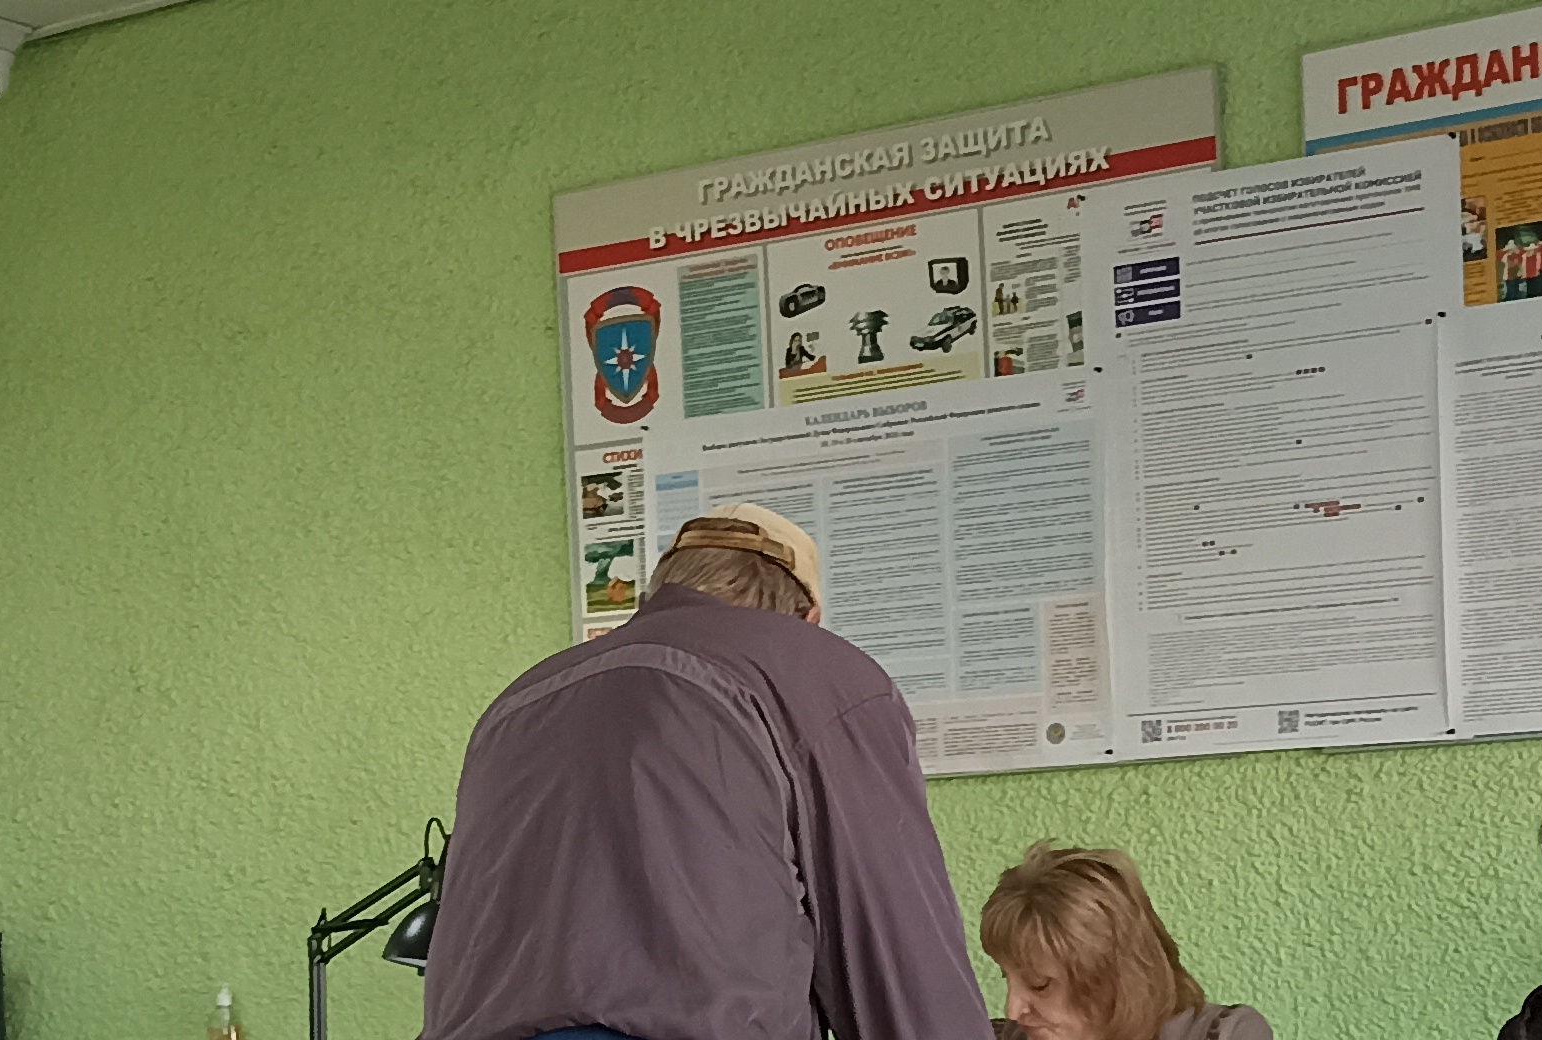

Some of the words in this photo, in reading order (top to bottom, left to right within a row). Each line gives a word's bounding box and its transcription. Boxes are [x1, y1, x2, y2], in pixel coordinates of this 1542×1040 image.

[649, 226, 667, 249] В
[674, 181, 915, 243] ЧРЕЗВЫЧАЙНЫХ
[924, 146, 1110, 200] СИТУАЦИЯХ
[697, 142, 911, 203] ГРАЖДАНСКАЯ
[920, 117, 1051, 161] ЗАЩИТА
